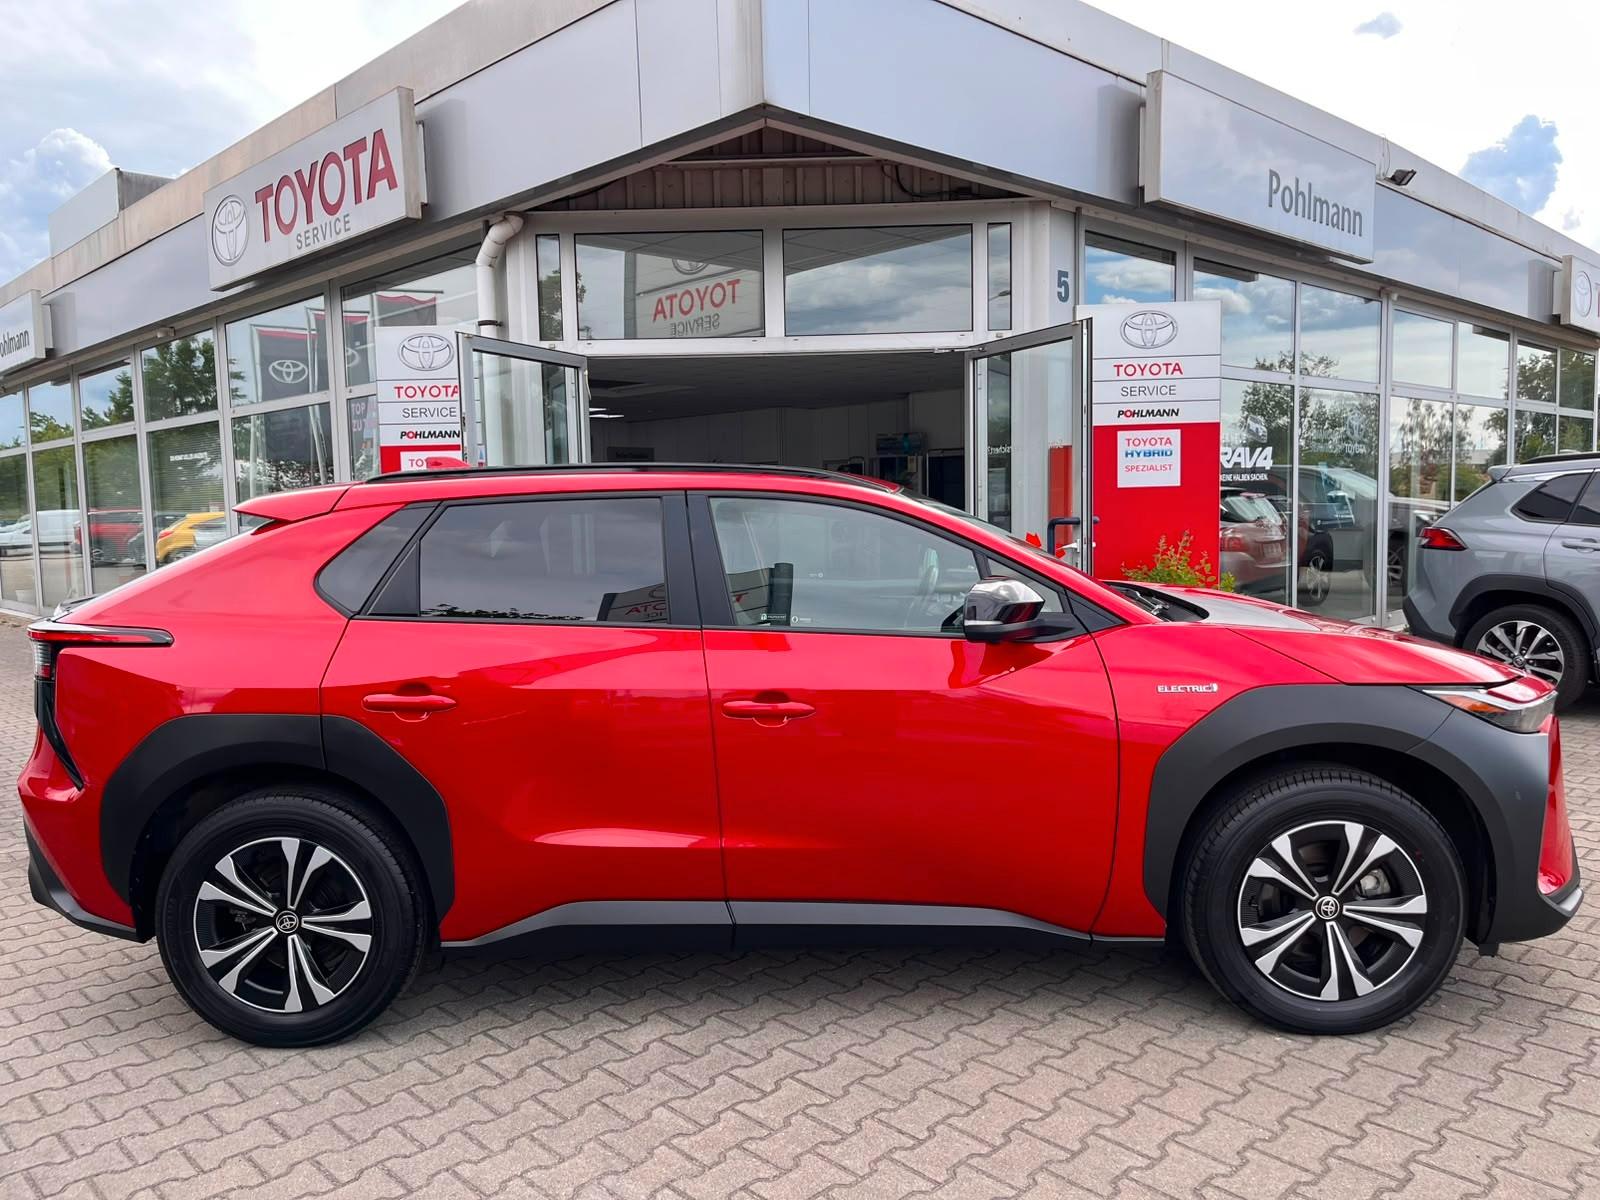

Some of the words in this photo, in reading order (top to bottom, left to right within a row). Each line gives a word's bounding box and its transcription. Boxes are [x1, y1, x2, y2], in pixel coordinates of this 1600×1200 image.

[255, 128, 398, 243] TOYOTA
[1268, 168, 1363, 237] Pohlmann
[296, 213, 352, 250] SERVICE
[1056, 269, 1070, 303] 5
[1113, 362, 1184, 377] TOYOTA
[394, 384, 460, 399] TOYOTA
[1120, 384, 1177, 397] SERVICE
[402, 406, 457, 418] SERVICE
[1117, 407, 1180, 418] POHLMANN
[400, 429, 461, 440] POHLMANN
[1125, 436, 1173, 447] TOYOTA
[1125, 449, 1174, 458] HYBRID
[1220, 446, 1273, 471] RAV4
[1124, 463, 1174, 473] SPEZIALIST
[1157, 684, 1213, 693] ELECTRIC
